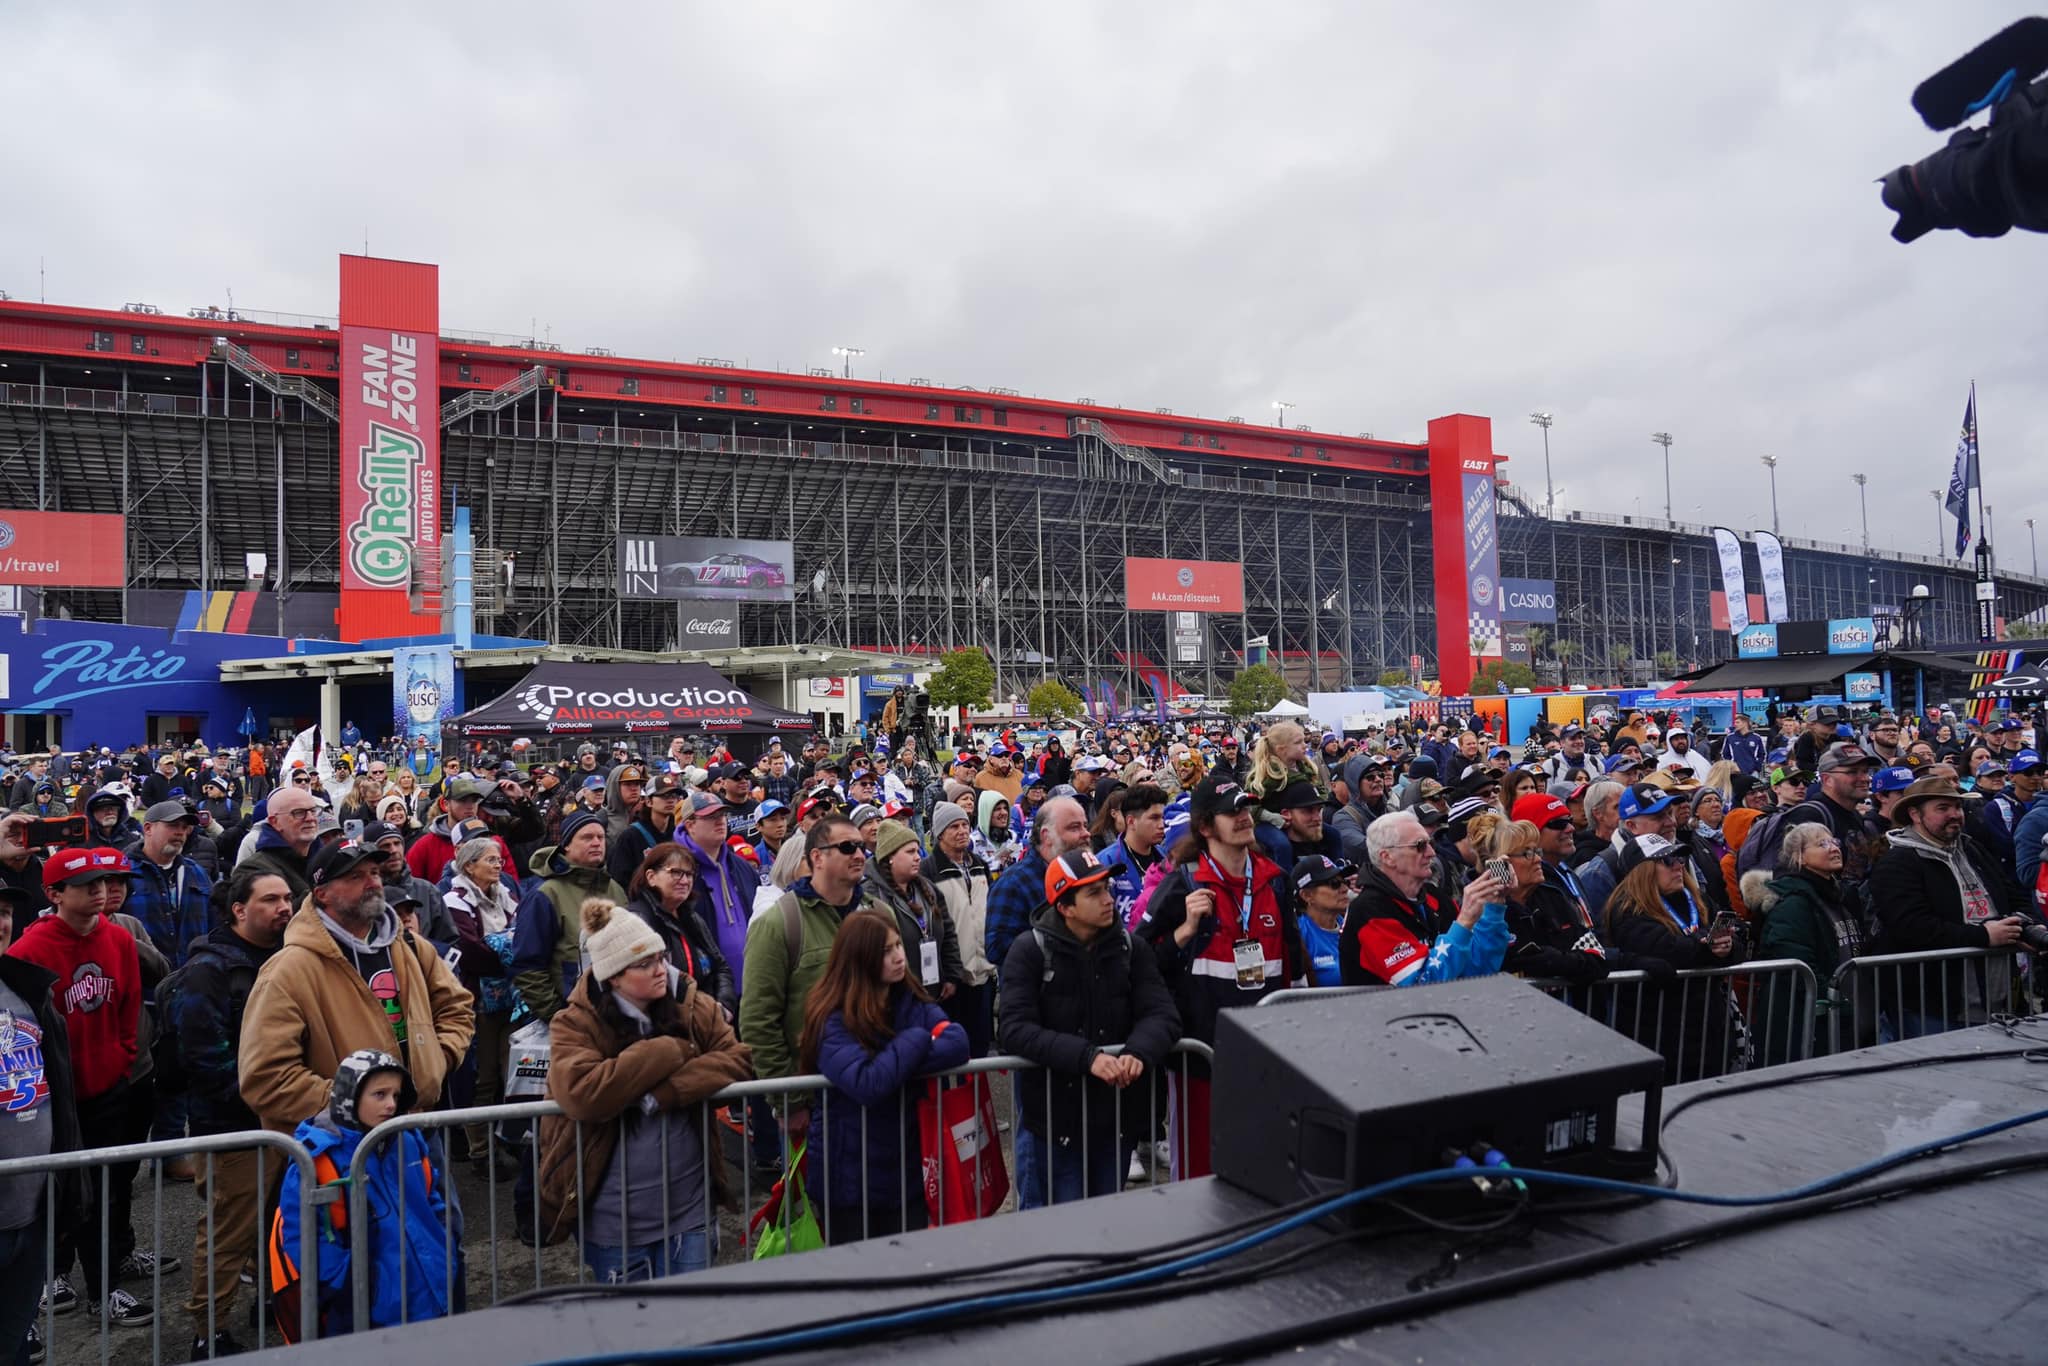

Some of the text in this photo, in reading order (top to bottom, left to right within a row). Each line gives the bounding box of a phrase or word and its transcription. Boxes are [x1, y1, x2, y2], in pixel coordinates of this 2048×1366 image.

[362, 344, 387, 409] FAN
[391, 333, 417, 426] ZONE
[1463, 459, 1489, 471] EAST
[354, 428, 420, 582] O'Reilly
[1466, 478, 1489, 514] AUTO
[421, 470, 433, 542] AUTO PARTS
[1467, 496, 1492, 534] HOME
[1471, 521, 1490, 551] LIFE
[625, 540, 658, 572] ALL
[626, 573, 658, 594] IN
[697, 566, 722, 582] 17
[1151, 592, 1221, 603] AAA.com/discounts
[1509, 592, 1555, 609] CASINO
[686, 618, 734, 635] Coca-Cola
[1742, 637, 1775, 649] BUSCH
[1832, 631, 1869, 644] BUSCH
[1509, 643, 1526, 652] 300
[33, 639, 187, 695] Patio
[407, 691, 440, 707] BUSCH
[548, 684, 748, 708] Production
[1976, 689, 2043, 699] OAKLEY
[556, 707, 753, 720] Alliance Group
[552, 721, 593, 729] Production
[1966, 900, 1989, 919] 78
[1259, 914, 1276, 927] 3
[1384, 946, 1417, 968] DAYTONA
[7, 1076, 37, 1111] 5
